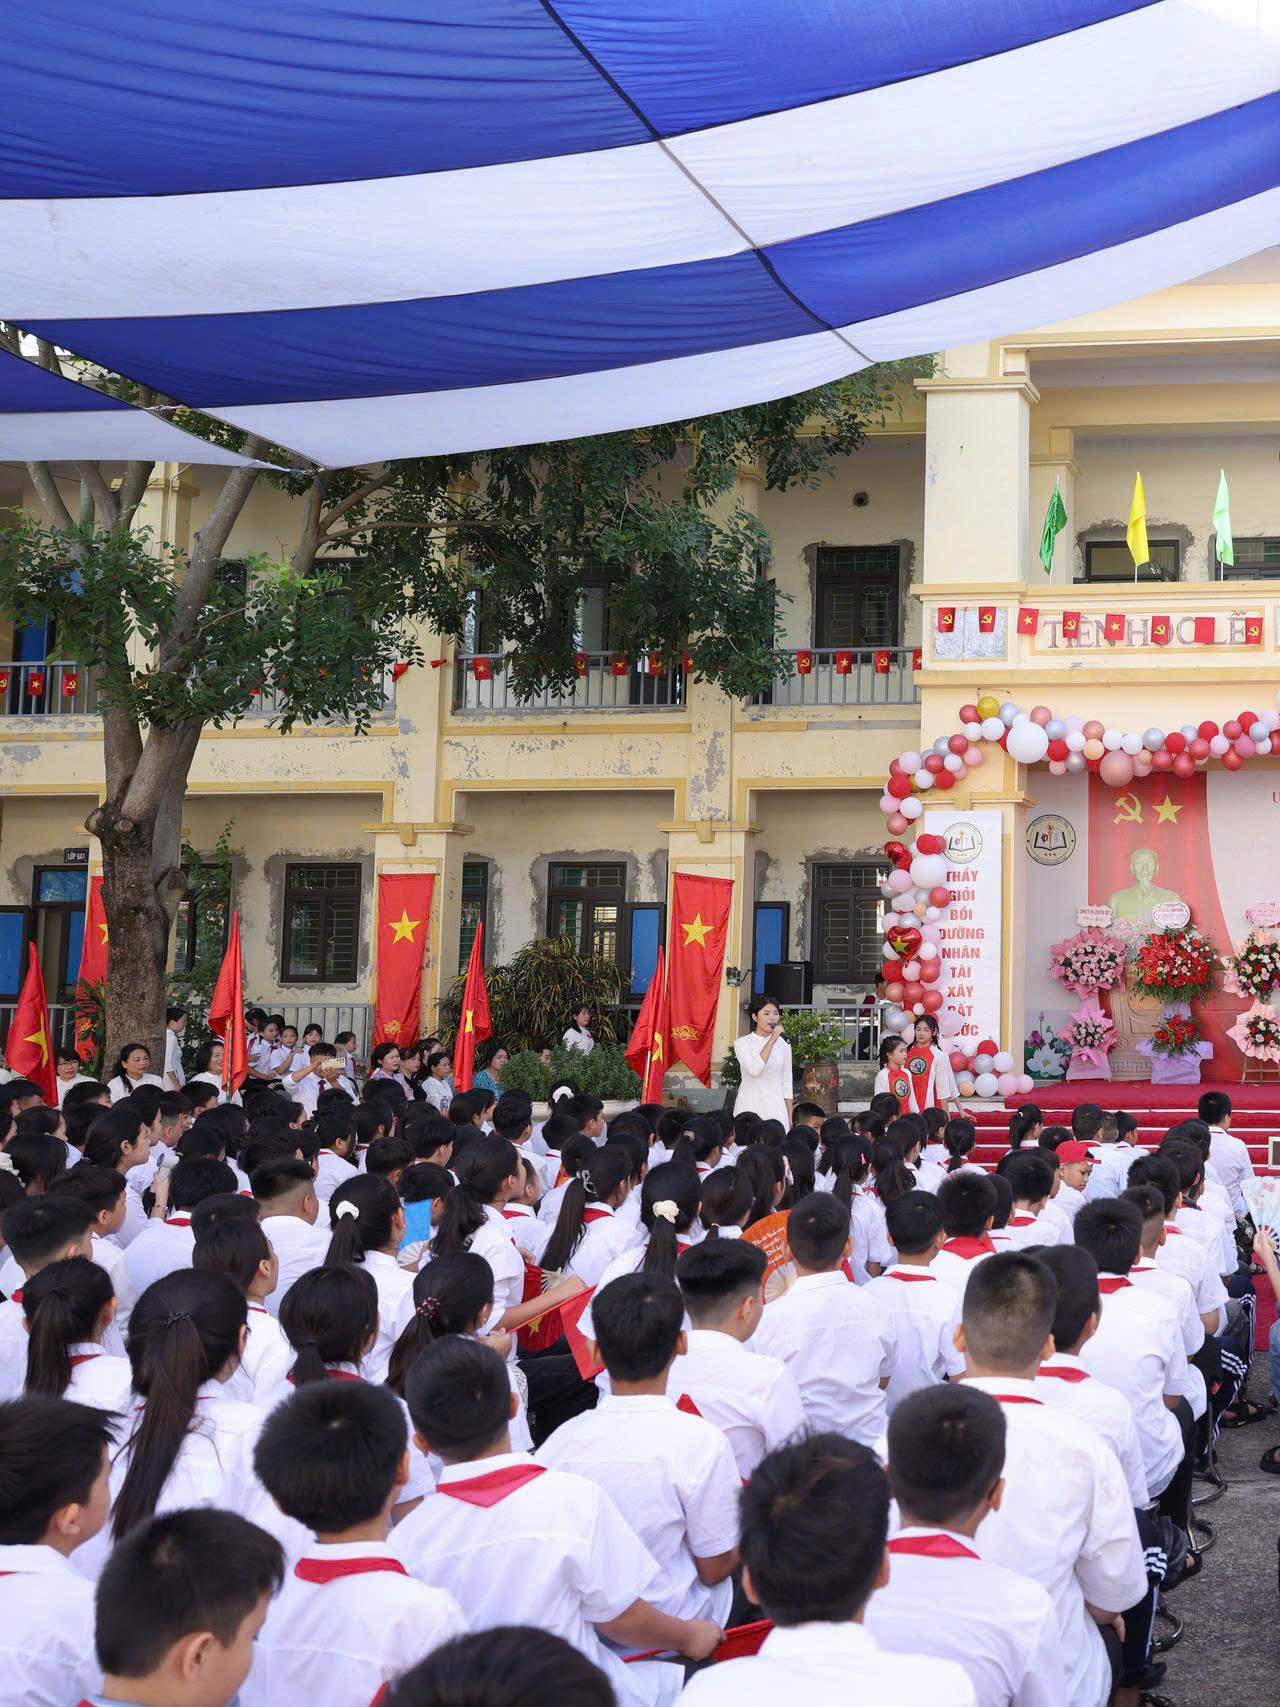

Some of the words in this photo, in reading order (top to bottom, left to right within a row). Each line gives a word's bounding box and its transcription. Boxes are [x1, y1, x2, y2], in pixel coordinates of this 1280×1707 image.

[949, 886, 975, 901] GIỎI
[941, 944, 980, 959] NHÂN
[947, 983, 974, 997] XÂY
[942, 1022, 979, 1036] ỚC
